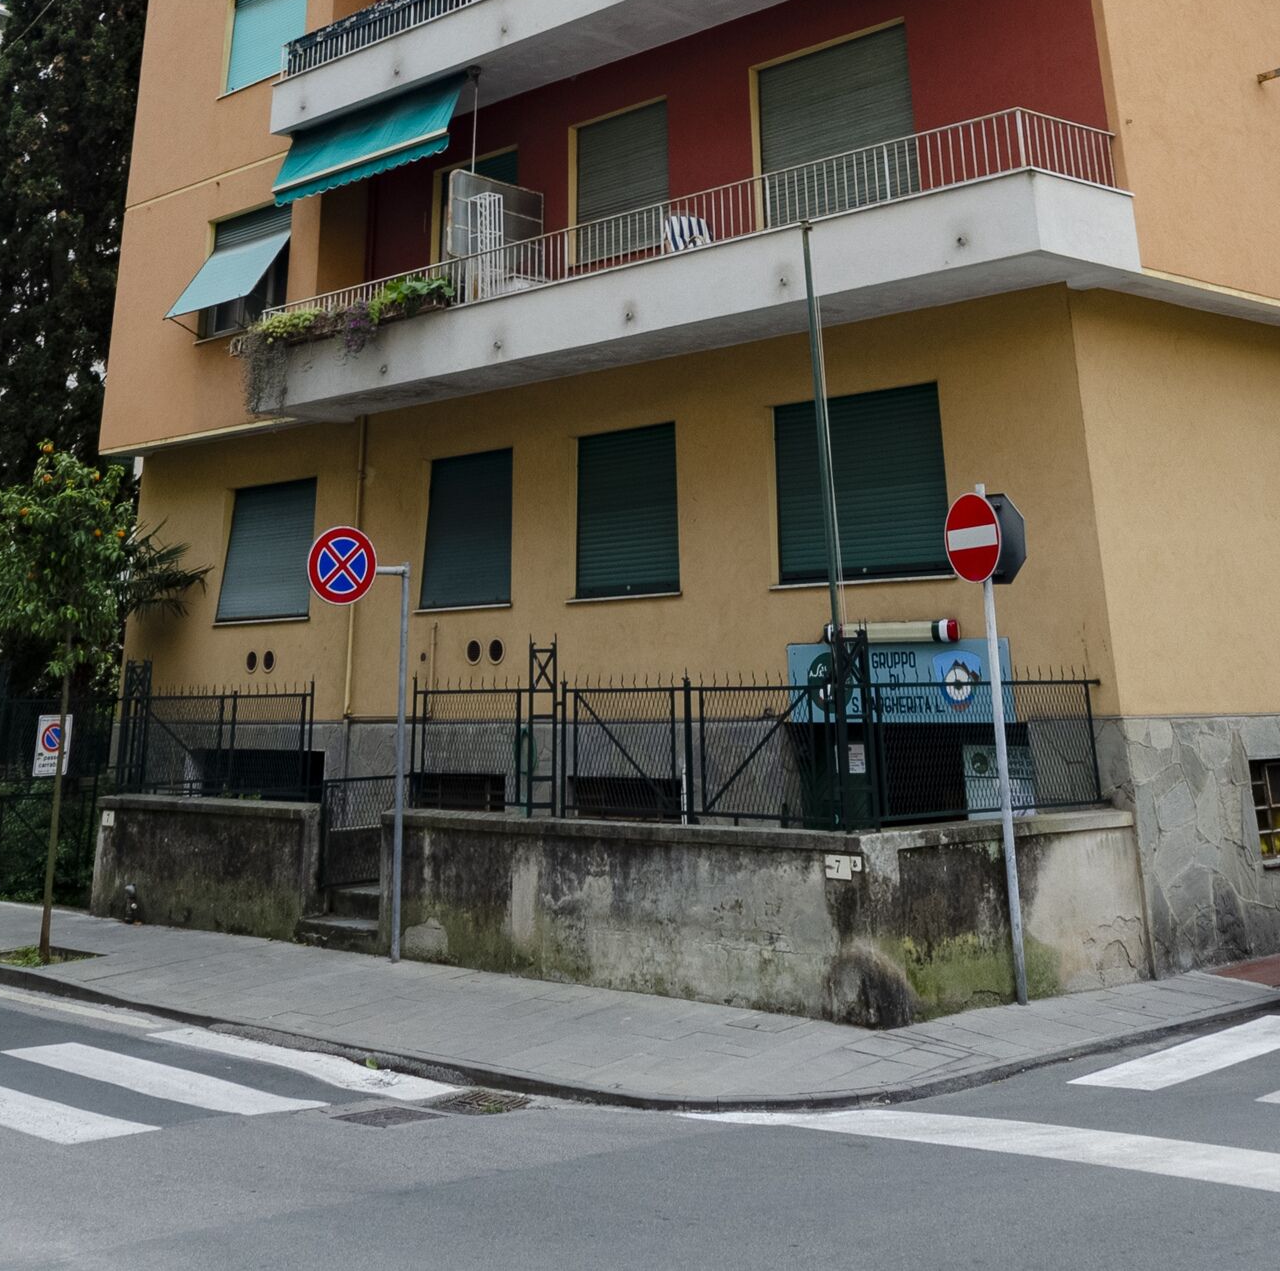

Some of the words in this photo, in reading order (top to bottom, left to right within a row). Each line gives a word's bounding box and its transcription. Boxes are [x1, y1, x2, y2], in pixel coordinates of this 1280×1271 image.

[871, 651, 916, 669] GRUPPO
[890, 674, 900, 691] DI
[863, 695, 932, 714] AGHERITA
[835, 859, 840, 873] 7
